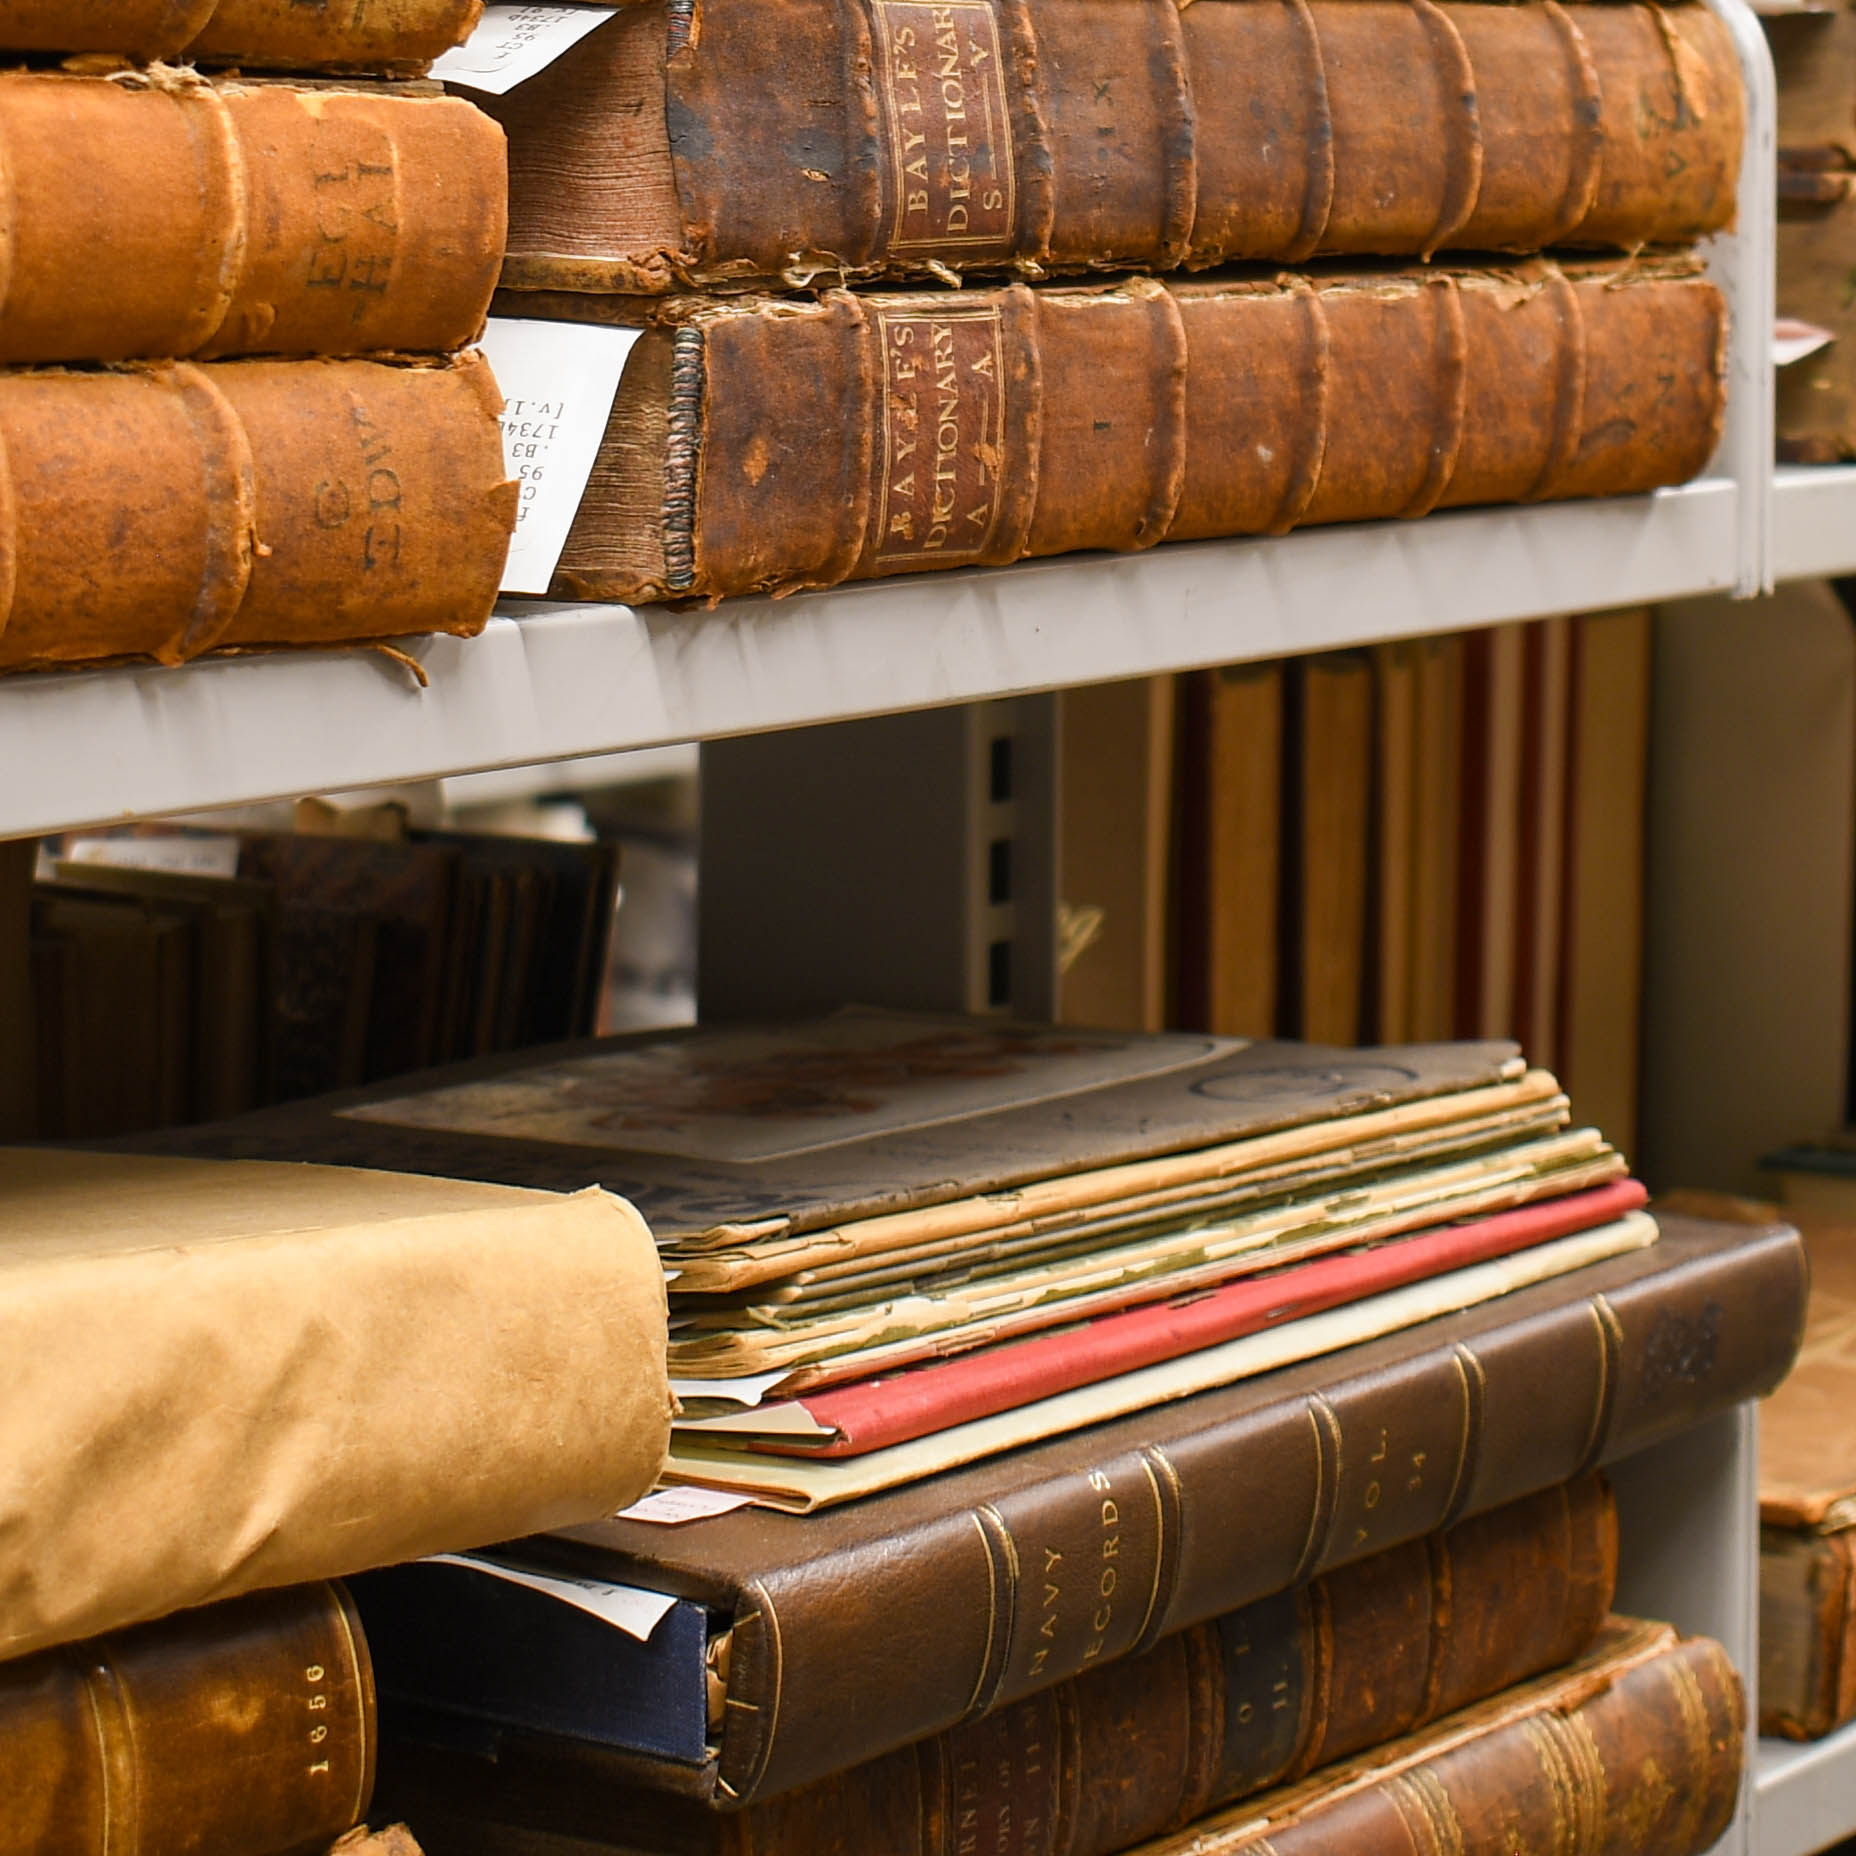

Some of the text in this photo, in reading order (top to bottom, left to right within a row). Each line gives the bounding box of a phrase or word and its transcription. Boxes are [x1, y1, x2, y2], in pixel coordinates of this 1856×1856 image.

[893, 25, 929, 215] BAYLE'S
[519, 464, 545, 480] 95
[923, 321, 959, 549] DICTIONARY
[1028, 1547, 1063, 1676] NAVY
[1077, 1470, 1121, 1674] ECORDS
[306, 1664, 330, 1777] 1656
